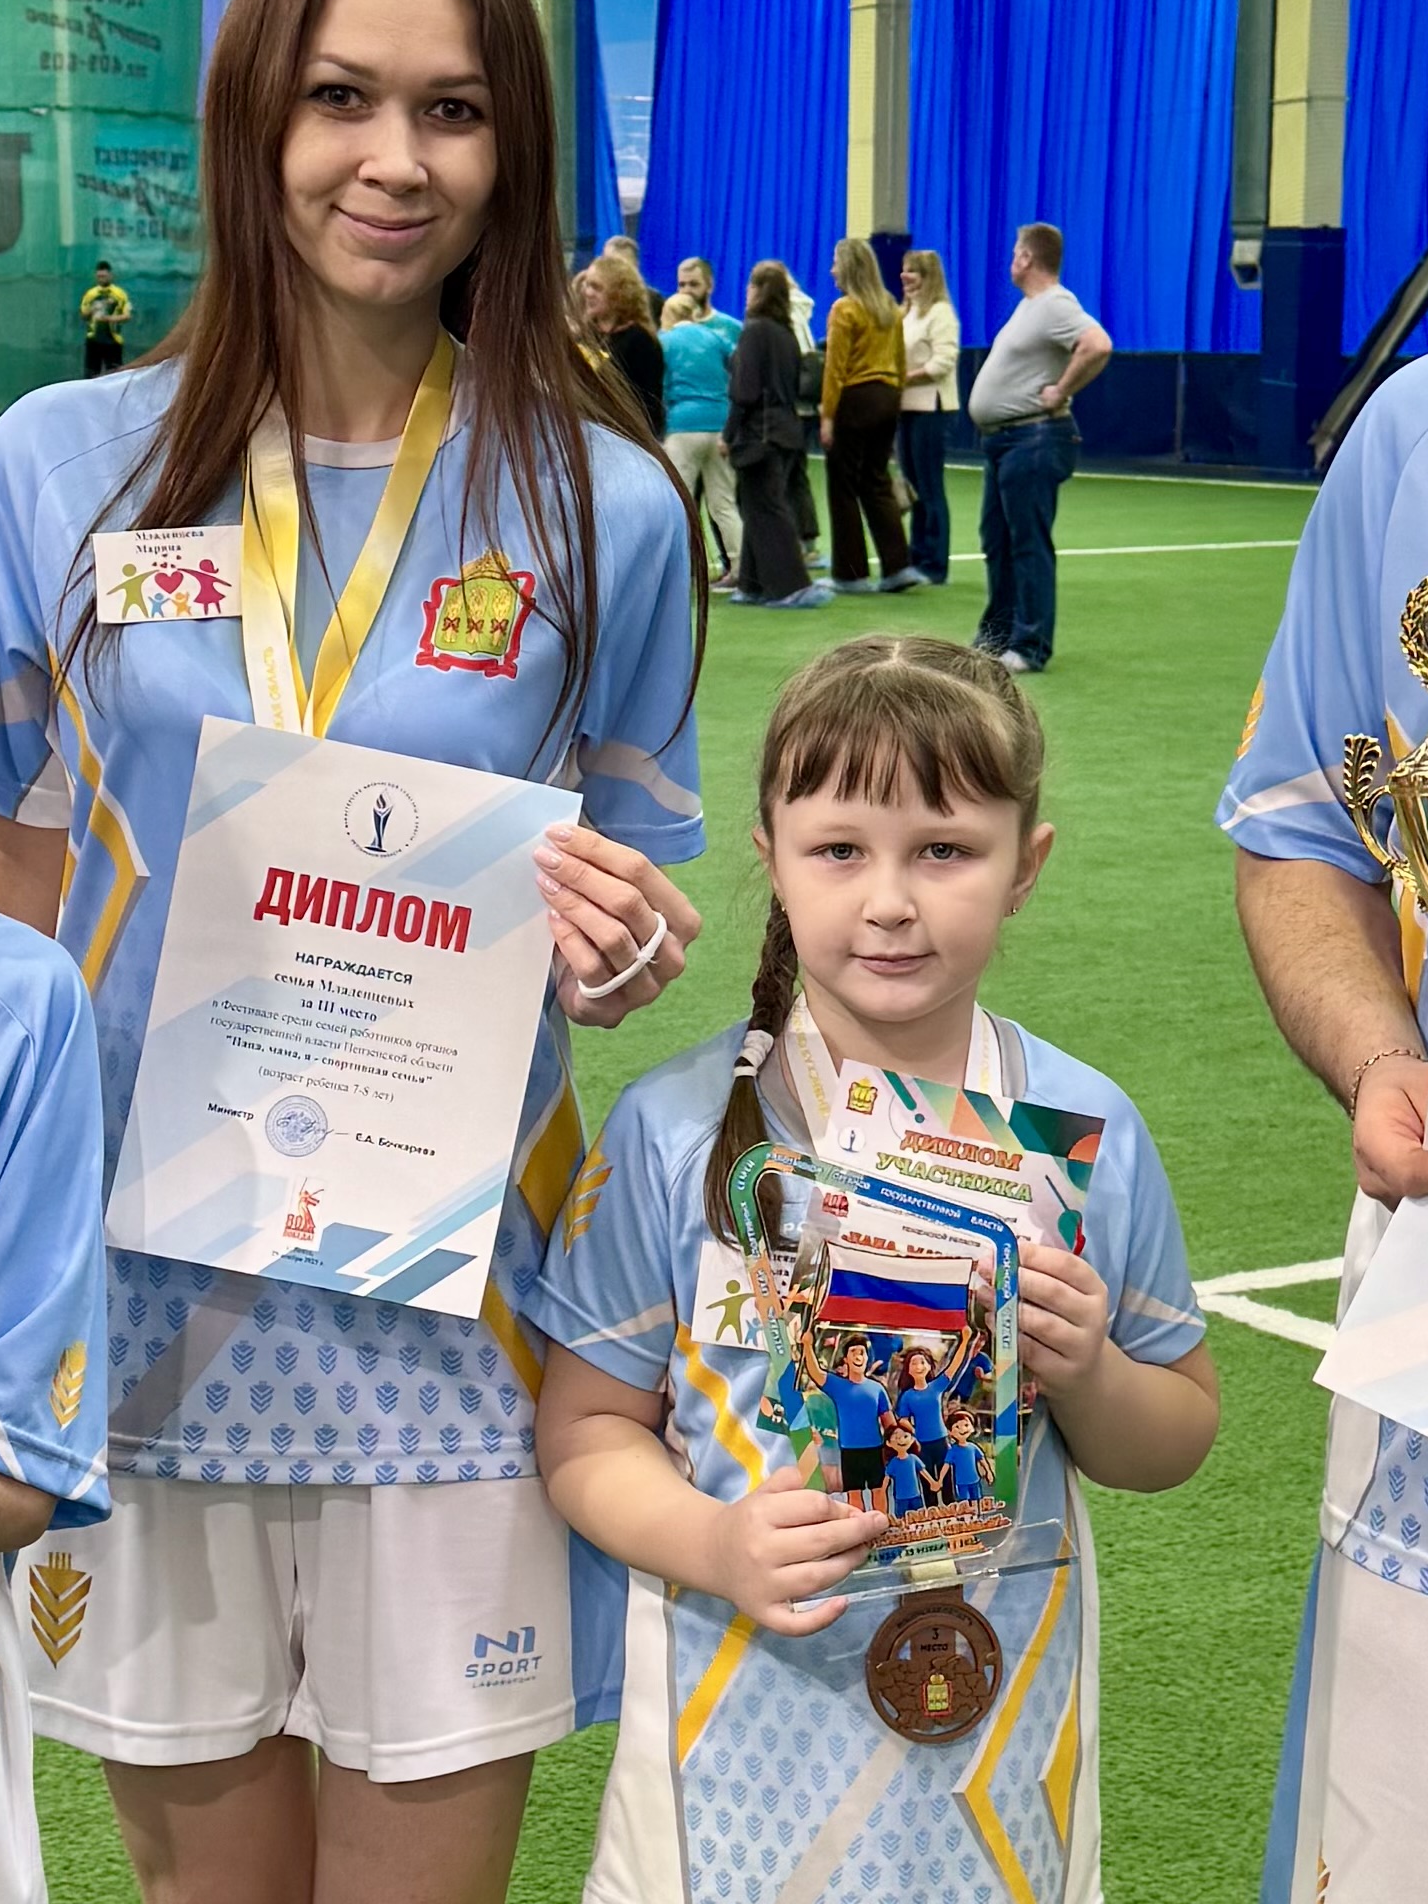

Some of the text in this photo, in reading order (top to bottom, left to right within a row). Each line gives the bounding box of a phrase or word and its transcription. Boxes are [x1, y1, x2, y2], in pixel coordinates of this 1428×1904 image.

[253, 867, 472, 953] ДИПЛОМ
[273, 971, 314, 989] семья
[295, 951, 414, 985] НАГРАЖДАЕТСЯ
[299, 997, 378, 1023] за III место
[207, 1101, 254, 1122] Министр
[900, 1130, 1023, 1171] ДИПЛОМ
[876, 1152, 1033, 1203] УЧАСТНИКА
[465, 1656, 543, 1677] SPORT
